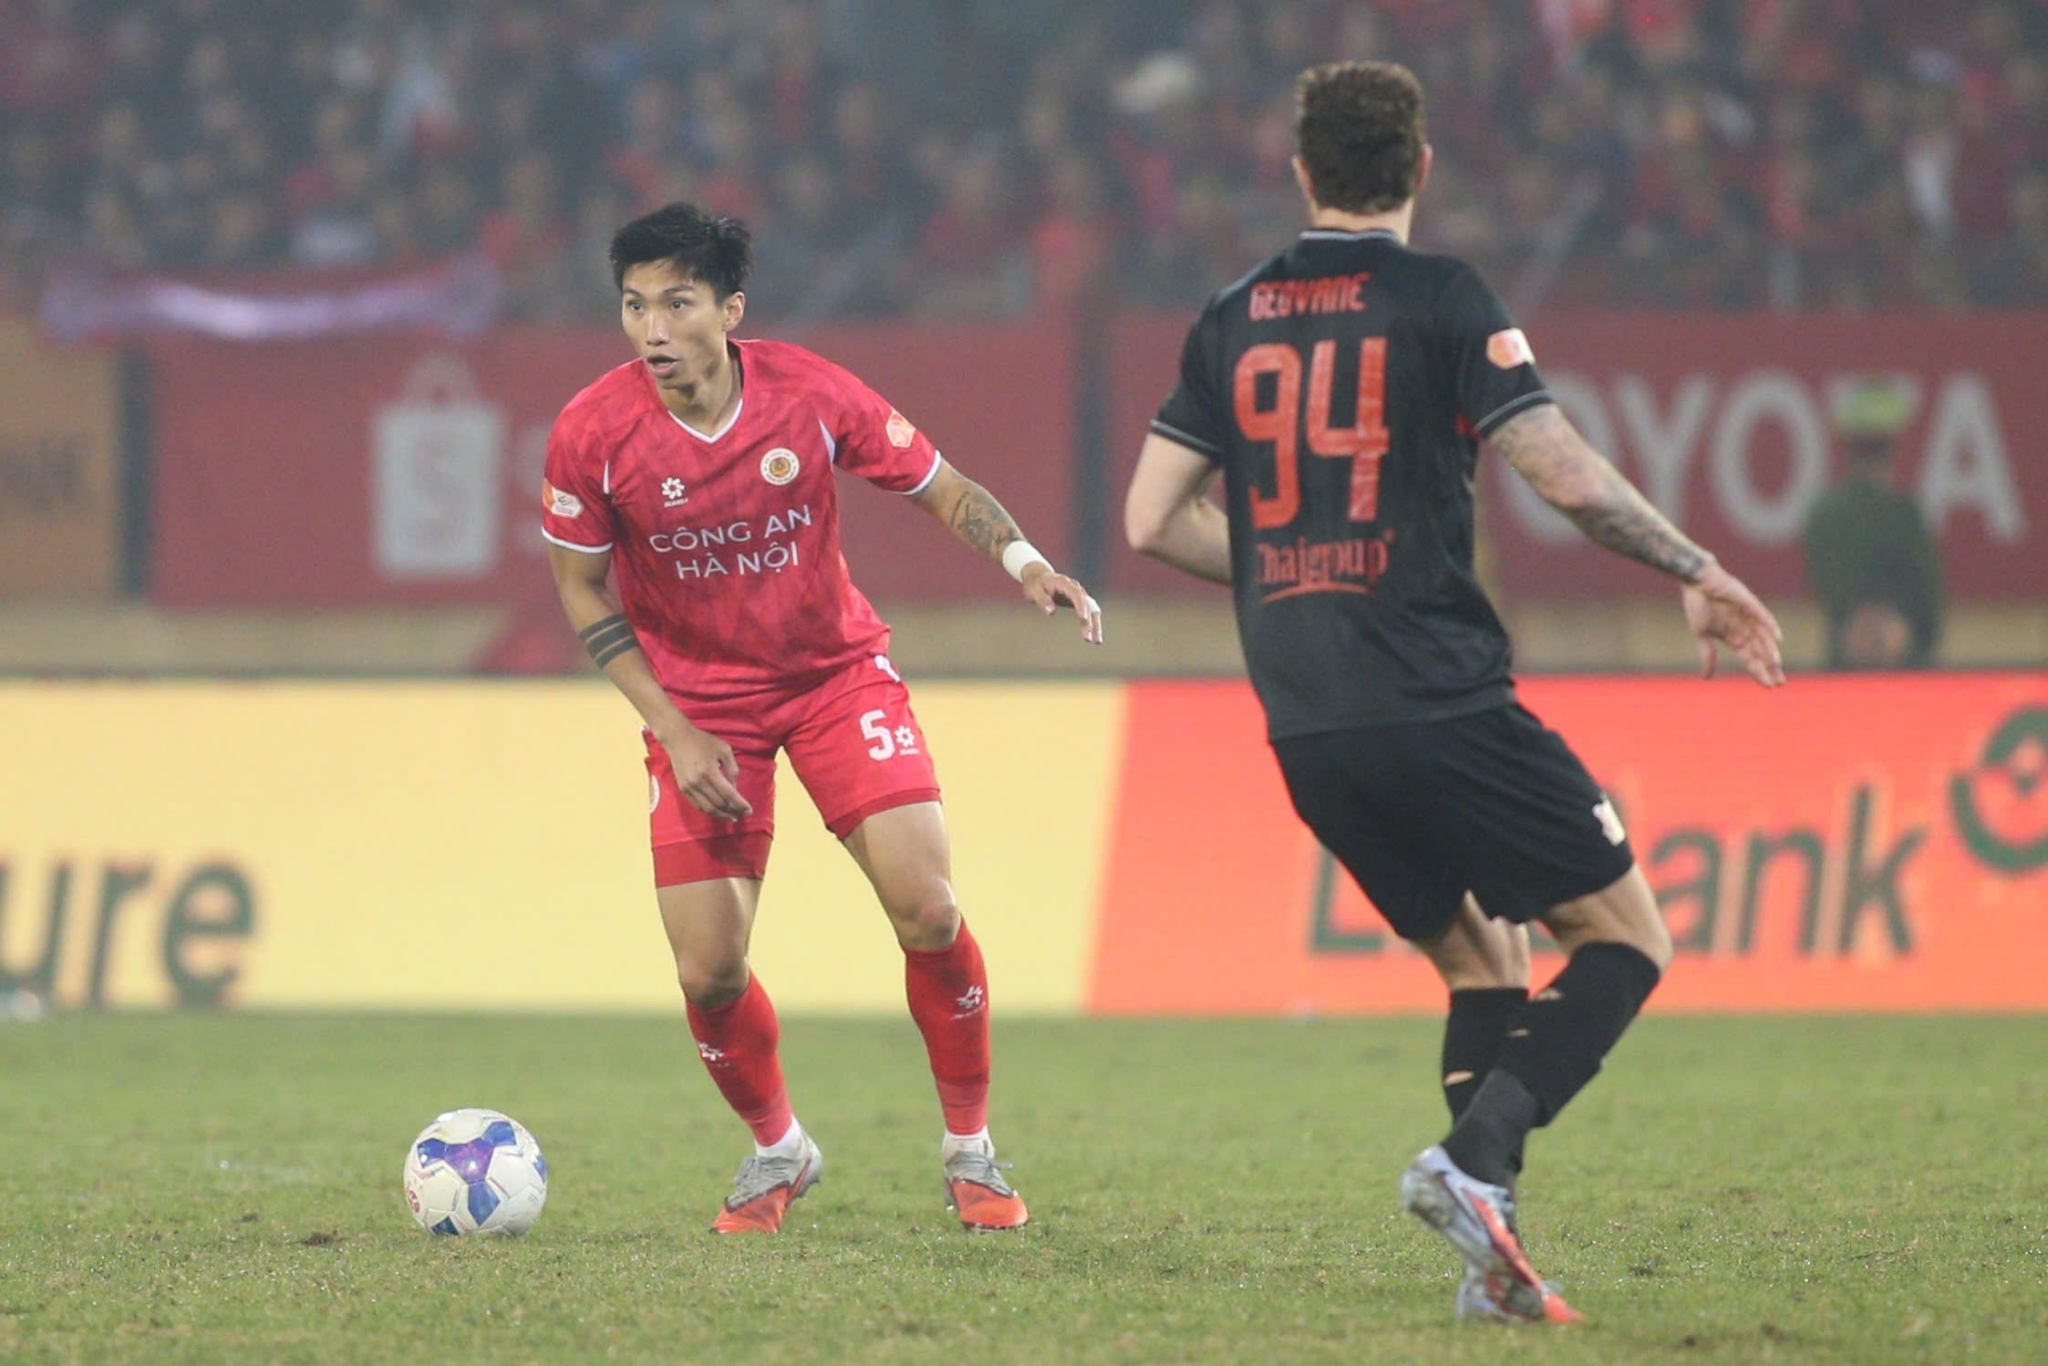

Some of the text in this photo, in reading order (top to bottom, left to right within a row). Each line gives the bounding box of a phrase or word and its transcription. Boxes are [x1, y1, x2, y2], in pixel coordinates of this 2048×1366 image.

[1233, 336, 1390, 530] 94
[1500, 370, 2024, 546] OYOA
[649, 504, 812, 553] CÔNG AN
[675, 540, 799, 580] HÀ NỘI
[859, 708, 896, 761] 5
[1308, 782, 1926, 957] Lank
